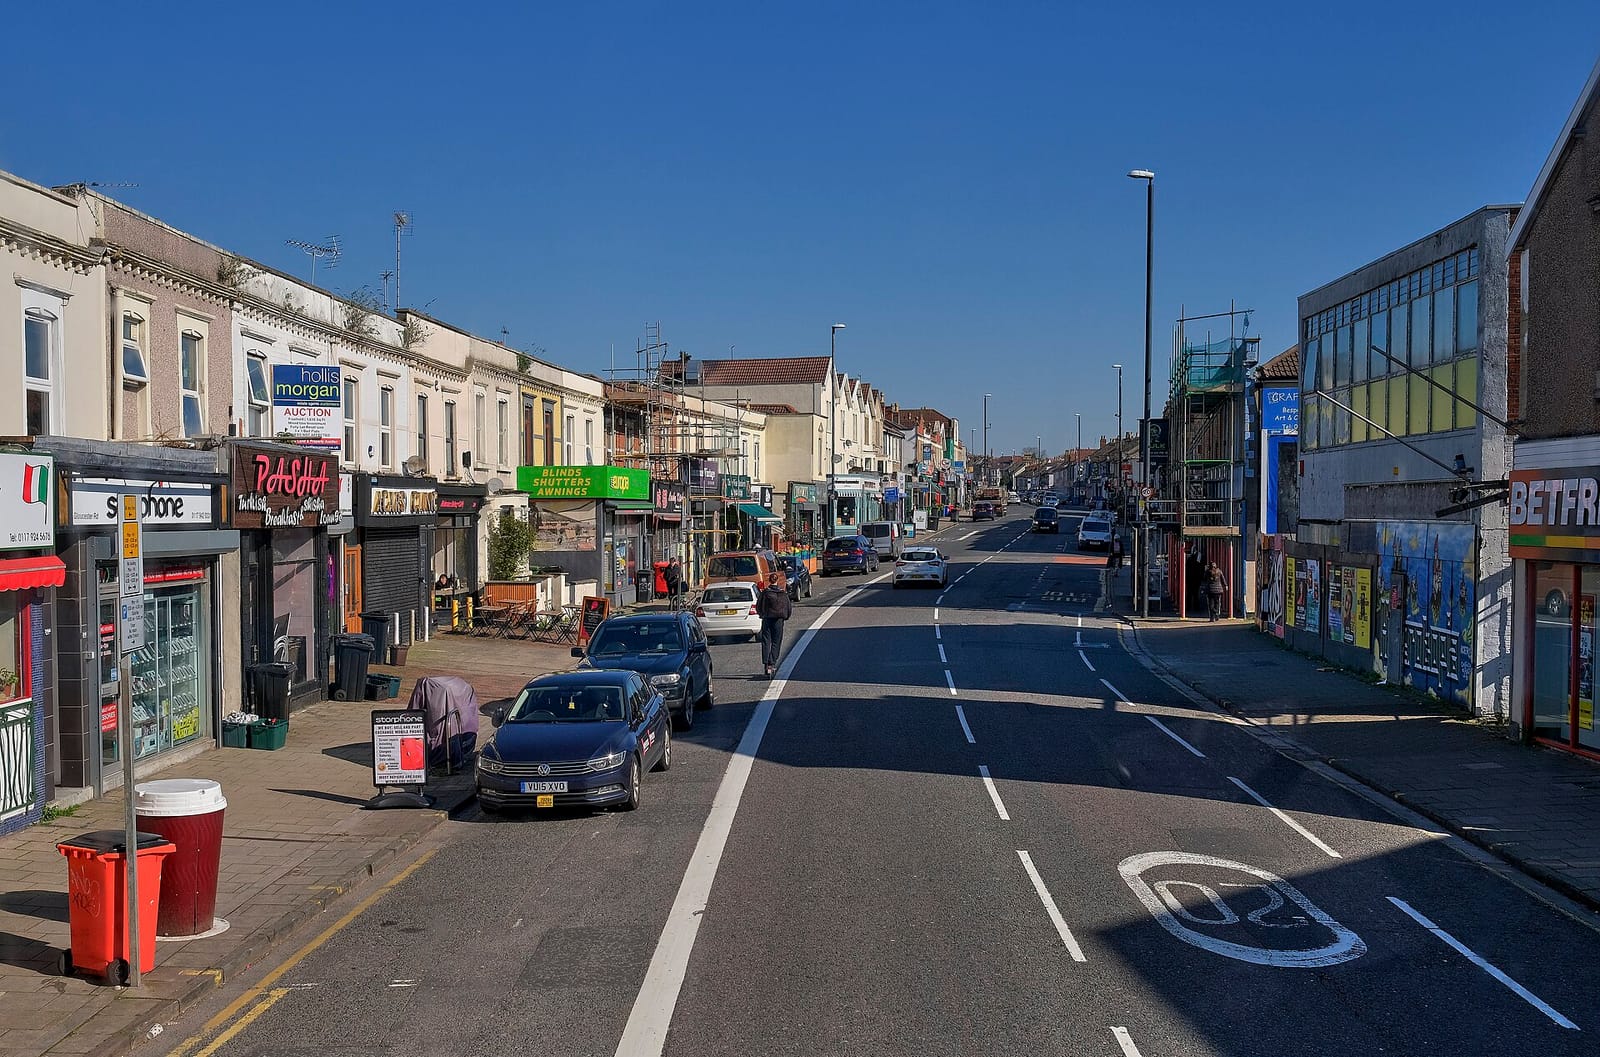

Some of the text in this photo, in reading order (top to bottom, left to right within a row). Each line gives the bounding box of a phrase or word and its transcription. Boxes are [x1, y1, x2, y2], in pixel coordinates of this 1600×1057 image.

[301, 367, 340, 384] hollis
[276, 383, 340, 400] morgan
[284, 407, 331, 417] AUCTION
[256, 454, 330, 497] PASHA
[542, 468, 582, 477] BLINDS
[533, 477, 592, 487] SHUTTERS
[536, 487, 588, 496] AWNINGS
[238, 492, 267, 512] Turkish
[1510, 477, 1600, 527] BETFR
[265, 505, 300, 526] Breakfast
[17, 532, 30, 542] 0117
[30, 532, 39, 542] 924
[527, 782, 565, 791] VU15 XVO
